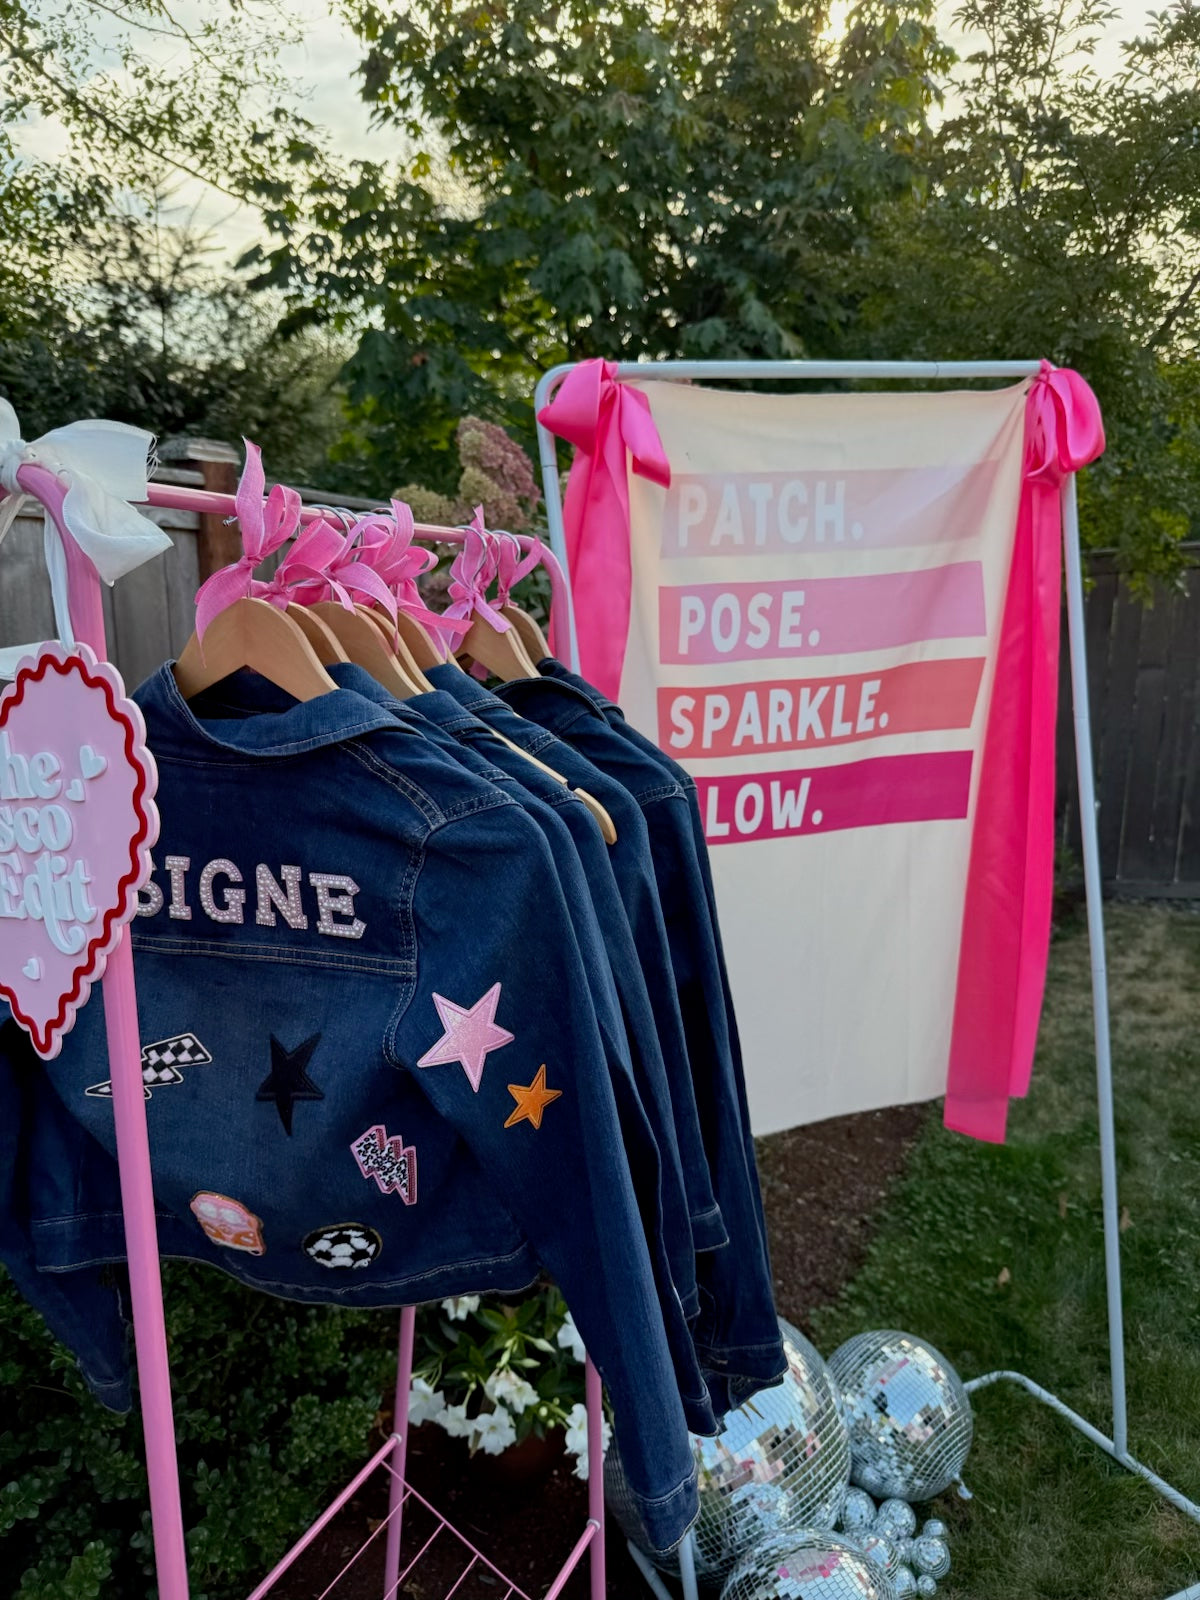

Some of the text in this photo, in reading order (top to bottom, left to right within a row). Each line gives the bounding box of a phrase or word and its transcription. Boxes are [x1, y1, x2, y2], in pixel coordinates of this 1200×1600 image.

[676, 479, 864, 548] PATCH.
[677, 590, 821, 655] POSE.
[668, 679, 890, 749] SPARKLE.
[0, 731, 63, 800] he
[0, 804, 73, 853] sco
[705, 777, 823, 837] LOW.
[0, 851, 98, 955] Edit
